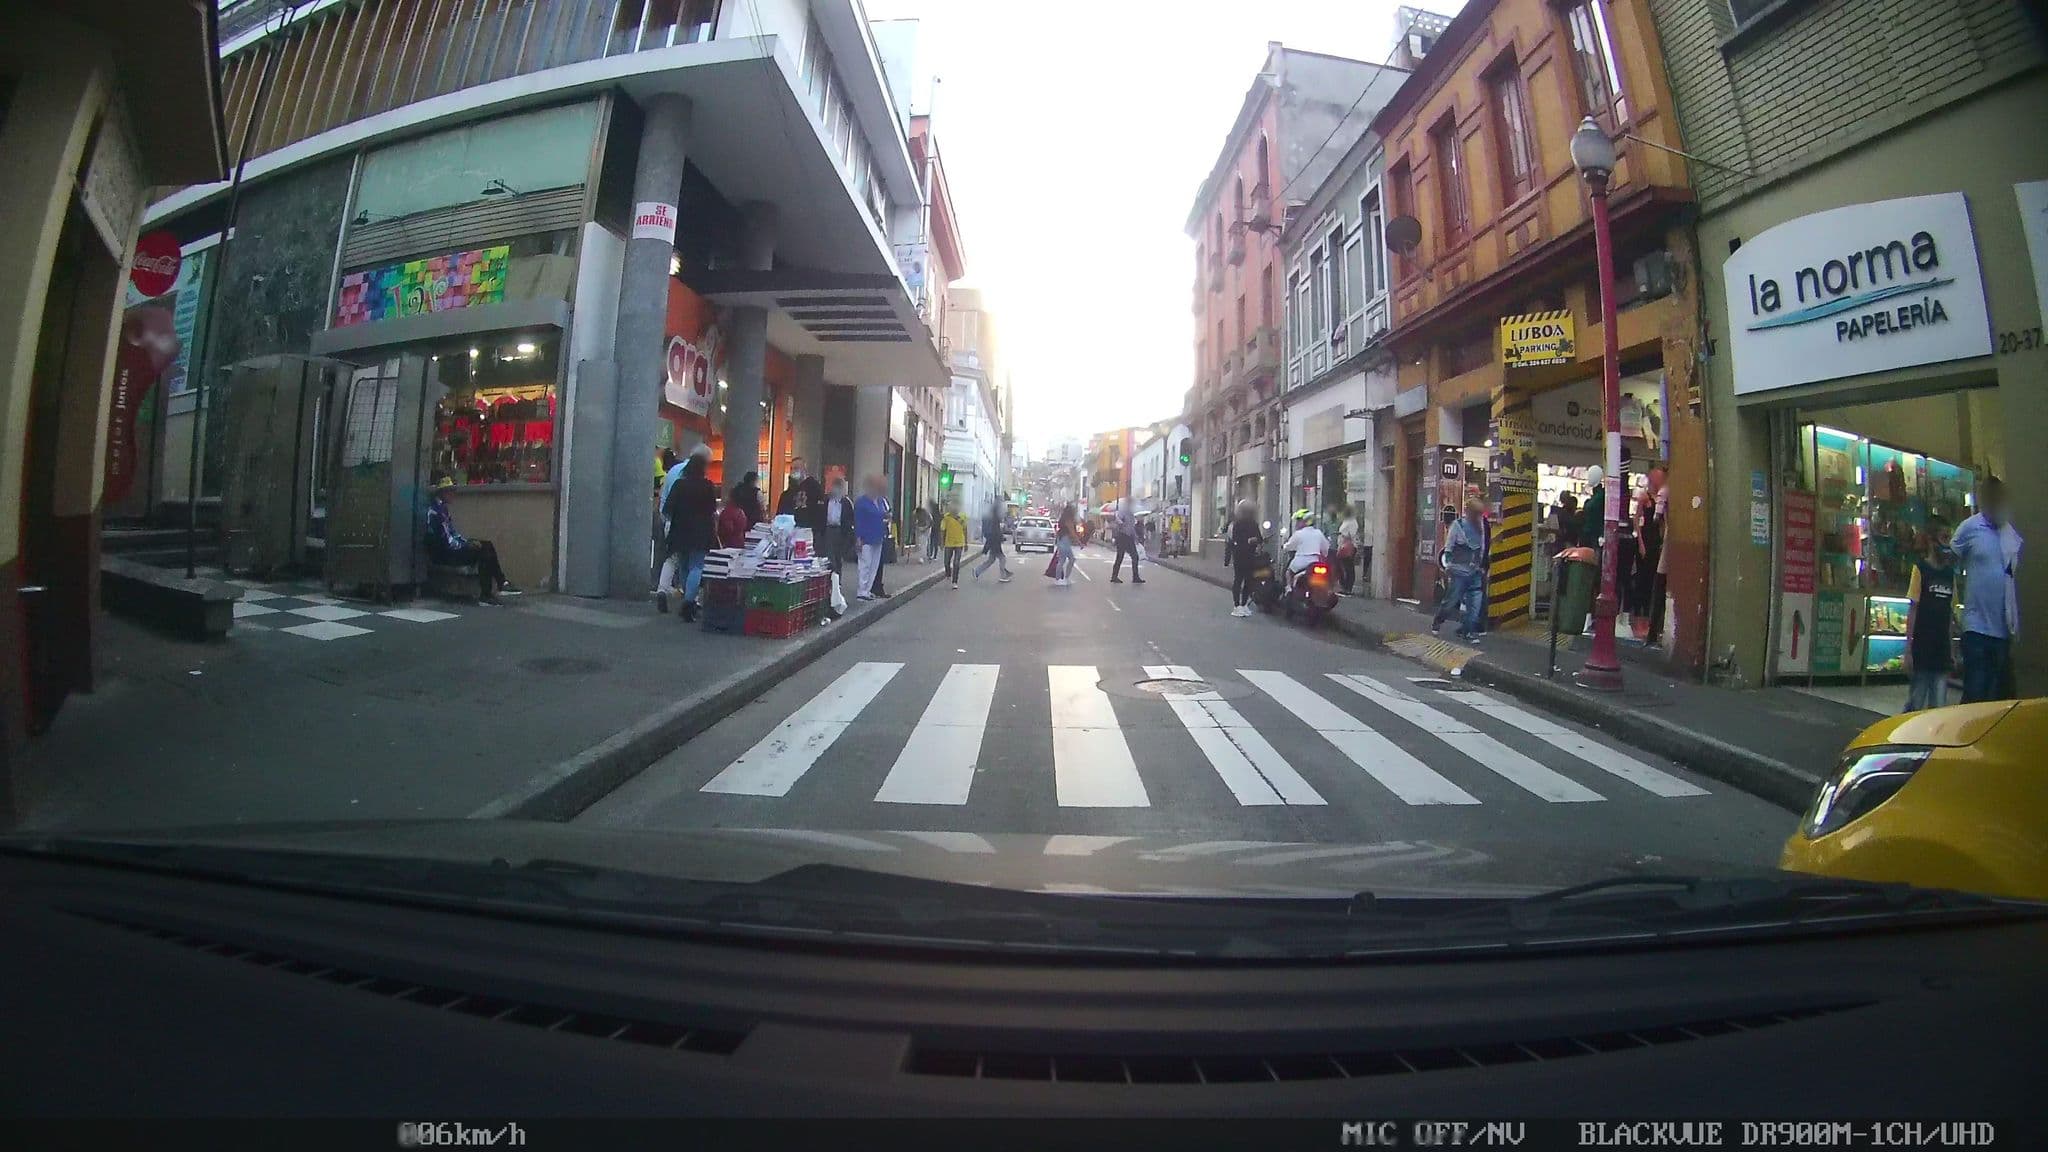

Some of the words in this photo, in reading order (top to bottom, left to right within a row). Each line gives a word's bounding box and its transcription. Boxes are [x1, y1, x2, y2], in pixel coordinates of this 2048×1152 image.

[655, 204, 668, 216] SE
[1748, 273, 1782, 315] la
[1794, 230, 1939, 303] norma
[1836, 296, 1949, 342] PAPELERÍA
[1511, 324, 1565, 342] LISBOA
[1519, 343, 1558, 354] PARKING
[1538, 421, 1593, 440] android
